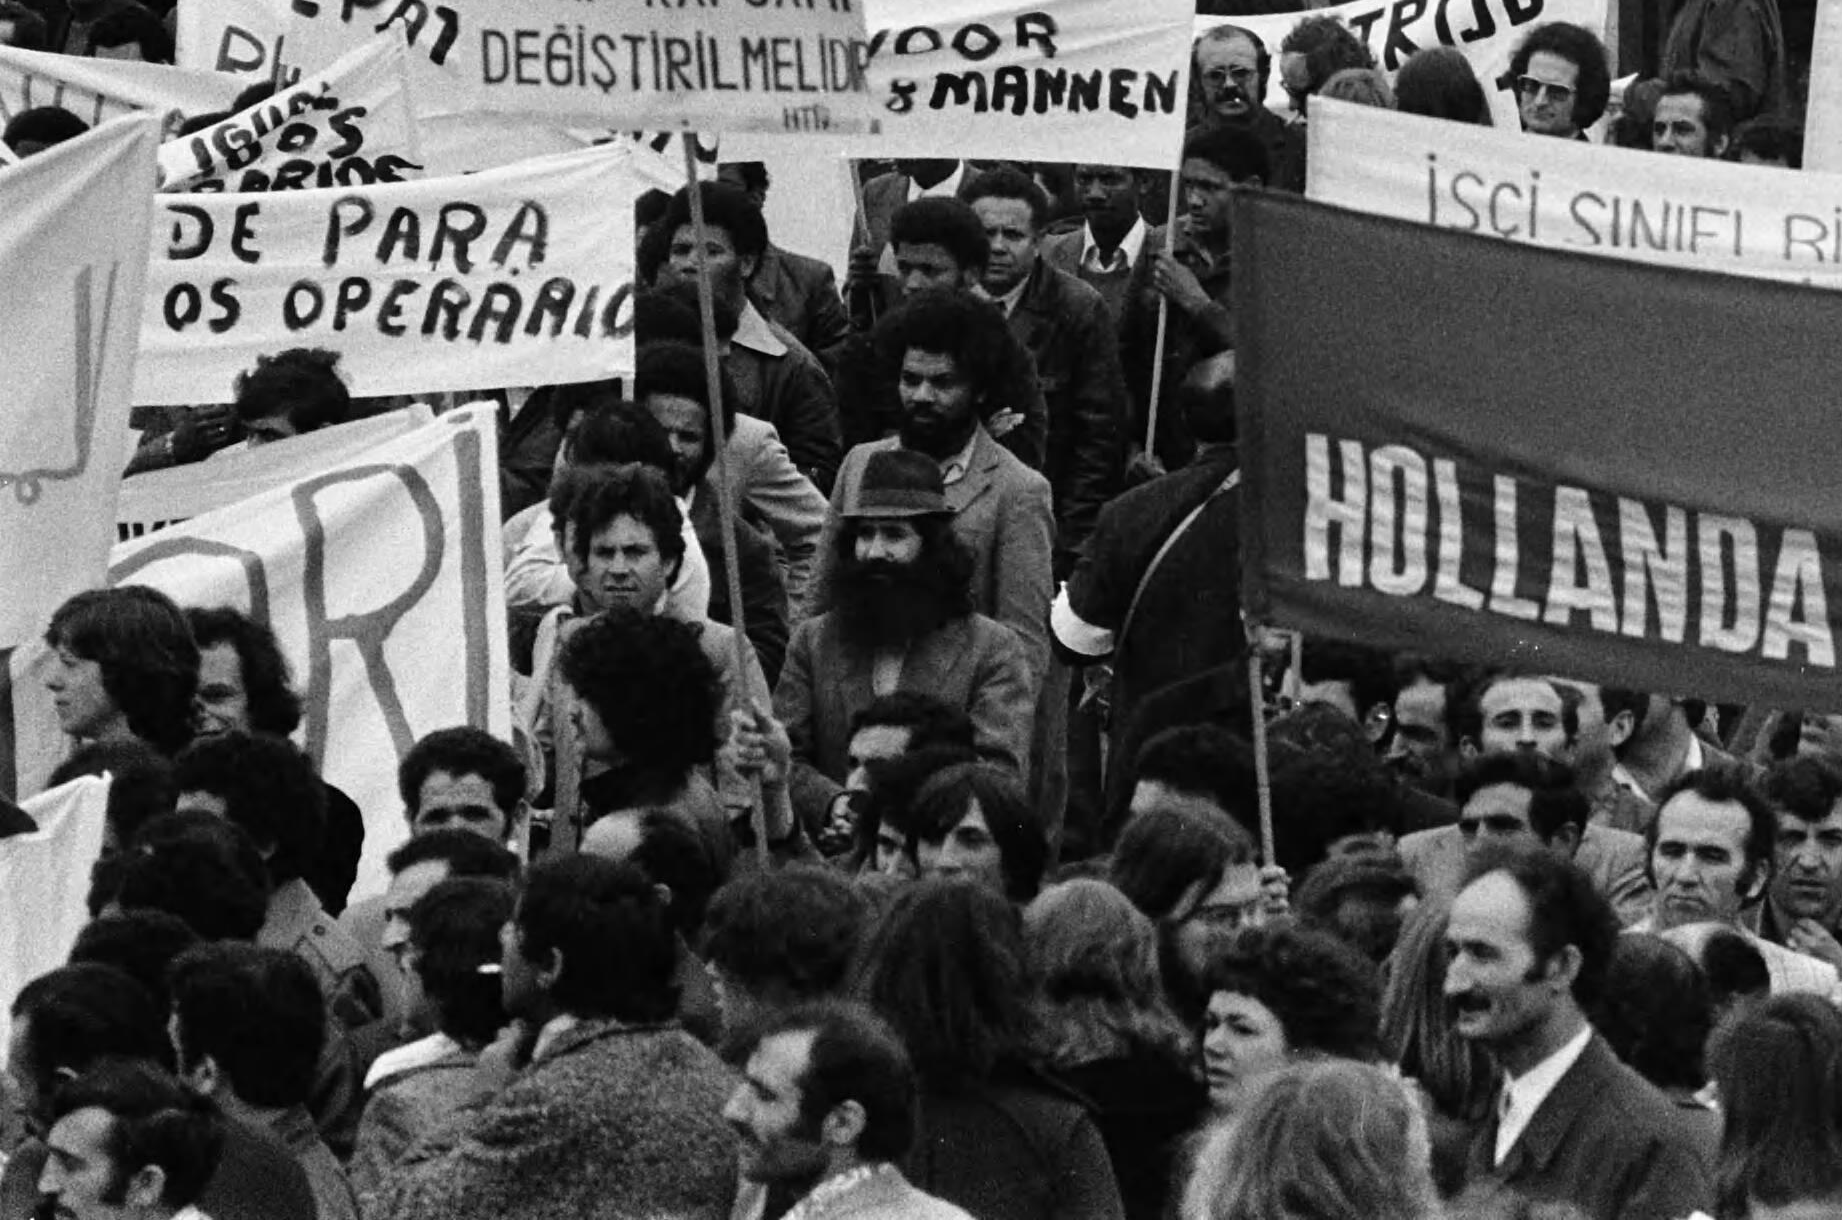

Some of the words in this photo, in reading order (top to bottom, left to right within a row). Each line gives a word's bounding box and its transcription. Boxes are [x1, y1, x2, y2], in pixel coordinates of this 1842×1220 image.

[929, 65, 1179, 120] MANNEN
[165, 201, 261, 264] DE
[322, 194, 549, 274] PARA
[163, 278, 241, 334] OS
[1303, 431, 1837, 669] HOLLANDA
